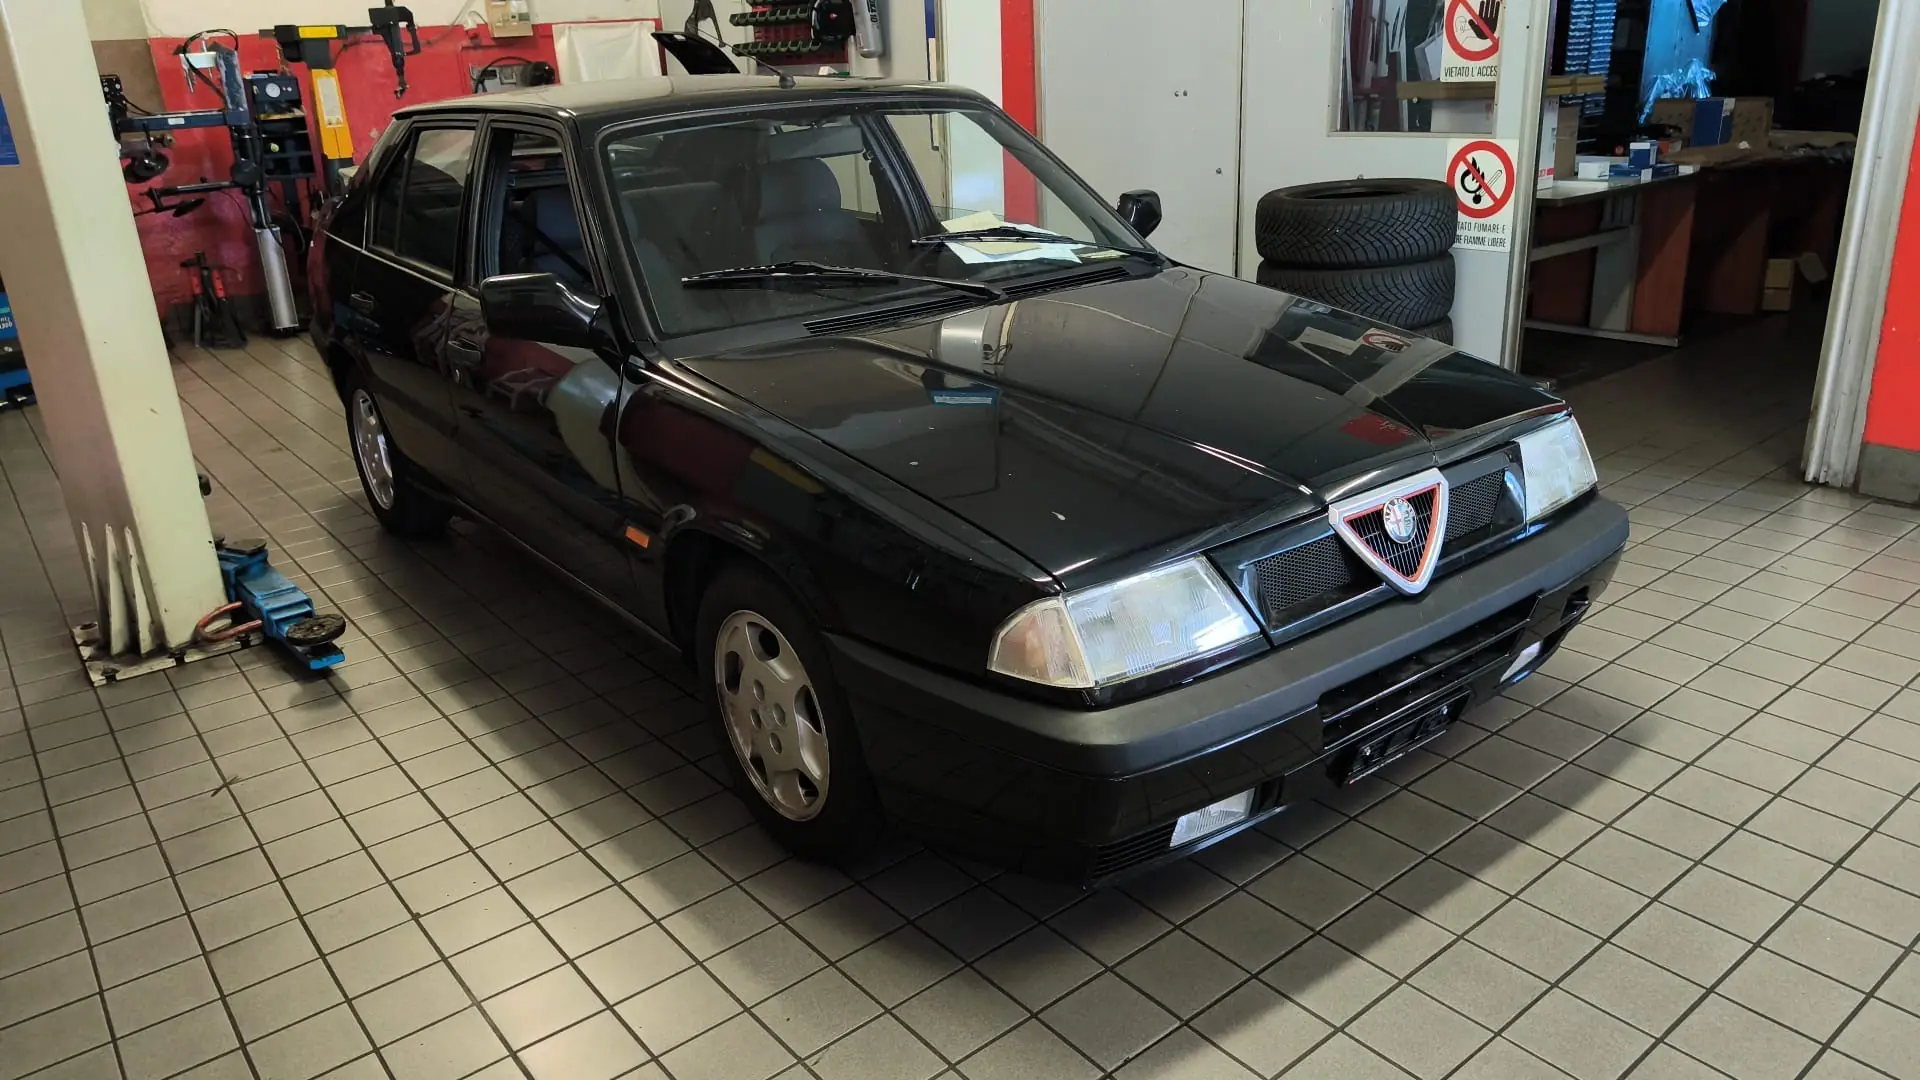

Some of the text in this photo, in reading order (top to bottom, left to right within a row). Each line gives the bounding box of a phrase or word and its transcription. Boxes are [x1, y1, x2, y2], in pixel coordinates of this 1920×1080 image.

[1444, 65, 1498, 77] VIETATO L'ACCES
[1457, 221, 1506, 233] TATO FUMARE E
[1463, 235, 1486, 246] FIAMME
[1487, 237, 1506, 247] LIBERE
